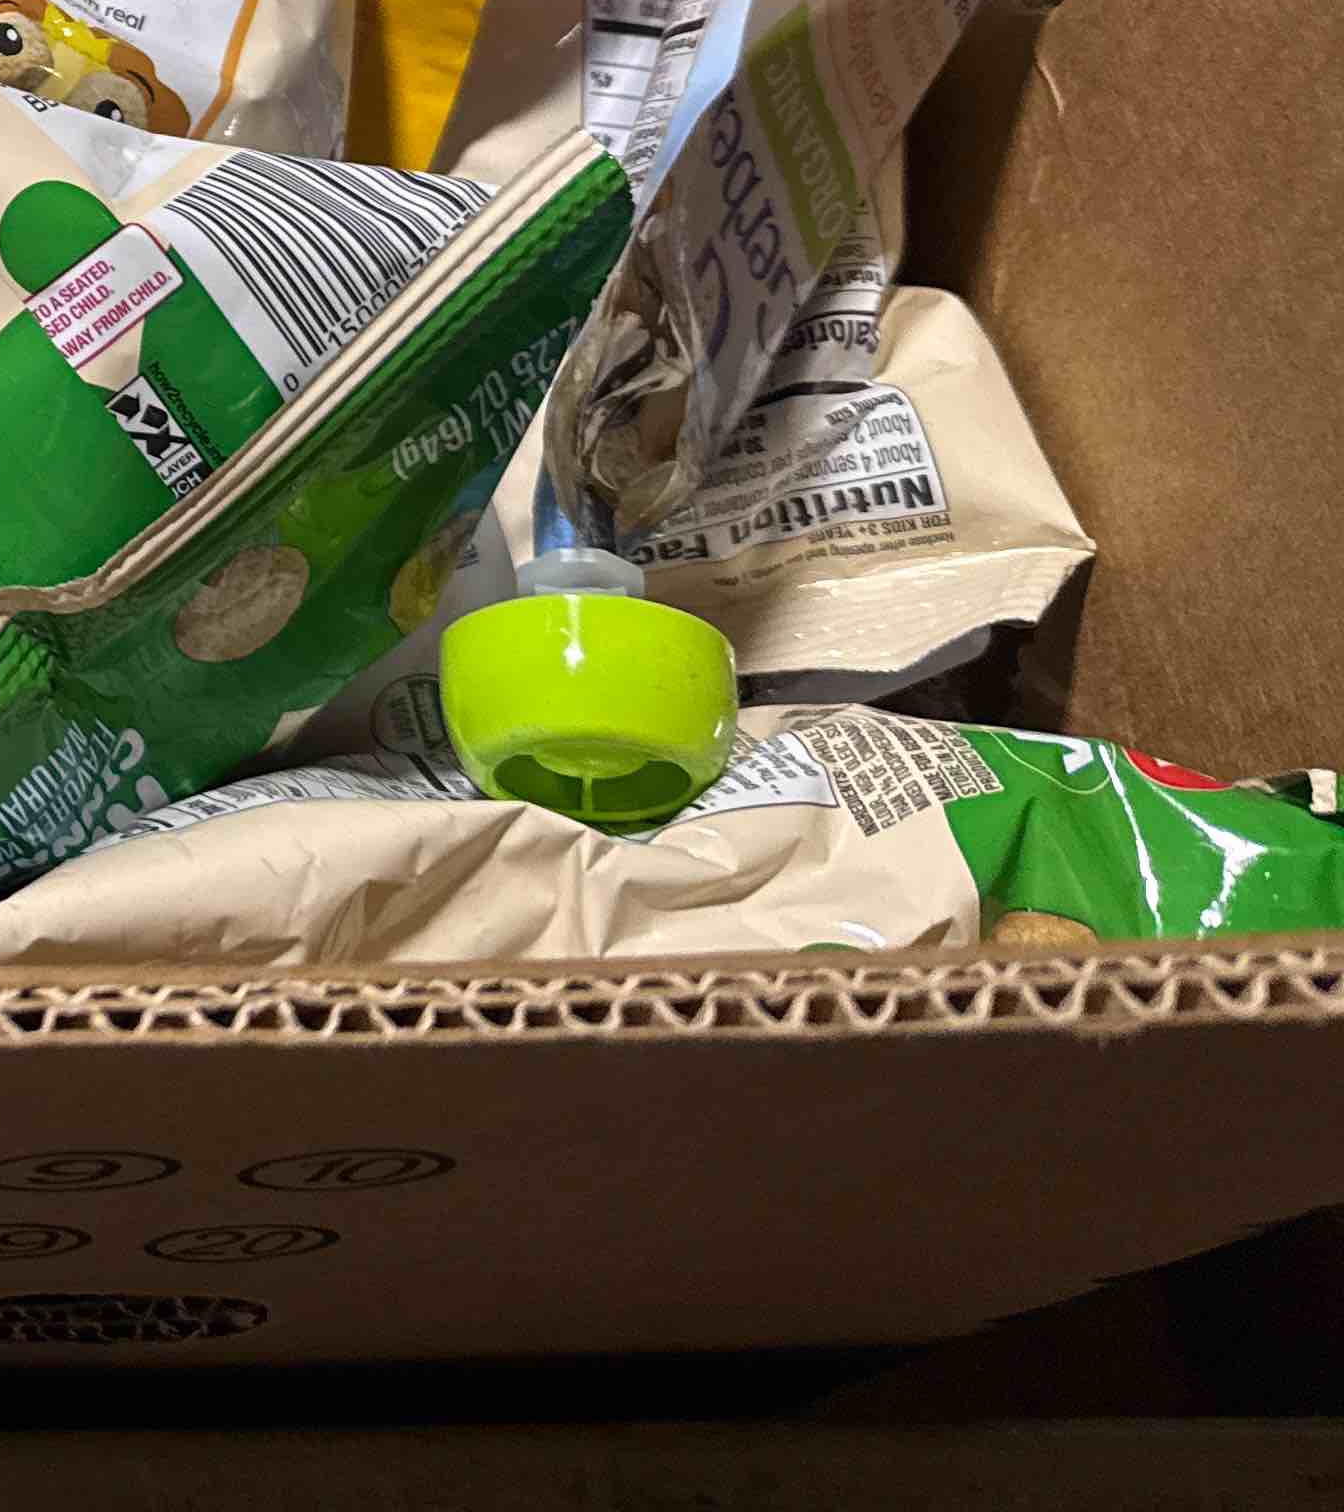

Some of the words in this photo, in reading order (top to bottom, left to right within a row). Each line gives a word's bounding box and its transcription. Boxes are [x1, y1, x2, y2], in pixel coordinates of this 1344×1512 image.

[729, 474, 935, 545] Nutrition
[630, 532, 709, 566] Fac
[172, 1228, 294, 1259] 20
